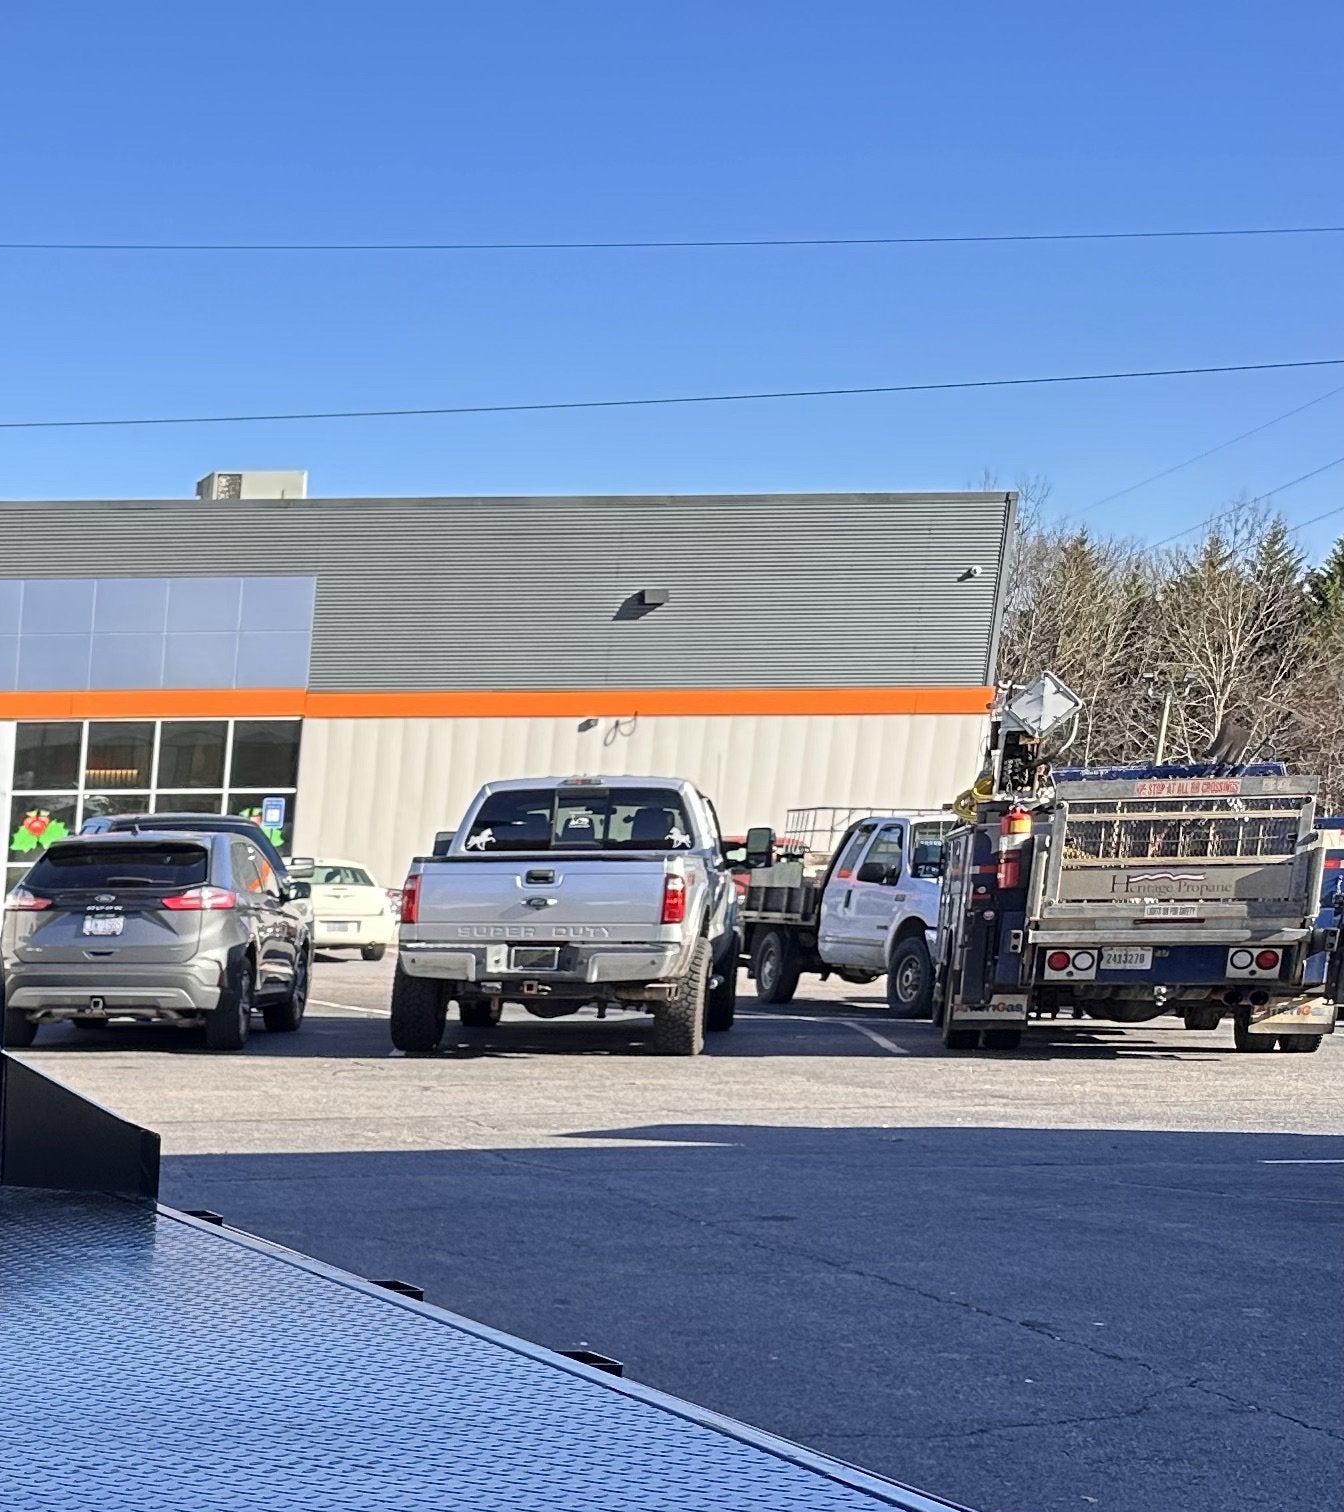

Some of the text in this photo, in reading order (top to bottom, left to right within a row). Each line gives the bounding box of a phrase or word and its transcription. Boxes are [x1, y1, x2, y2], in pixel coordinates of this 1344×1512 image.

[1148, 783, 1166, 795] STOP
[1167, 783, 1176, 795] AT
[1177, 782, 1188, 794] ALL
[1110, 874, 1233, 896] Heritage Propane
[457, 926, 610, 937] SUPER DUTY
